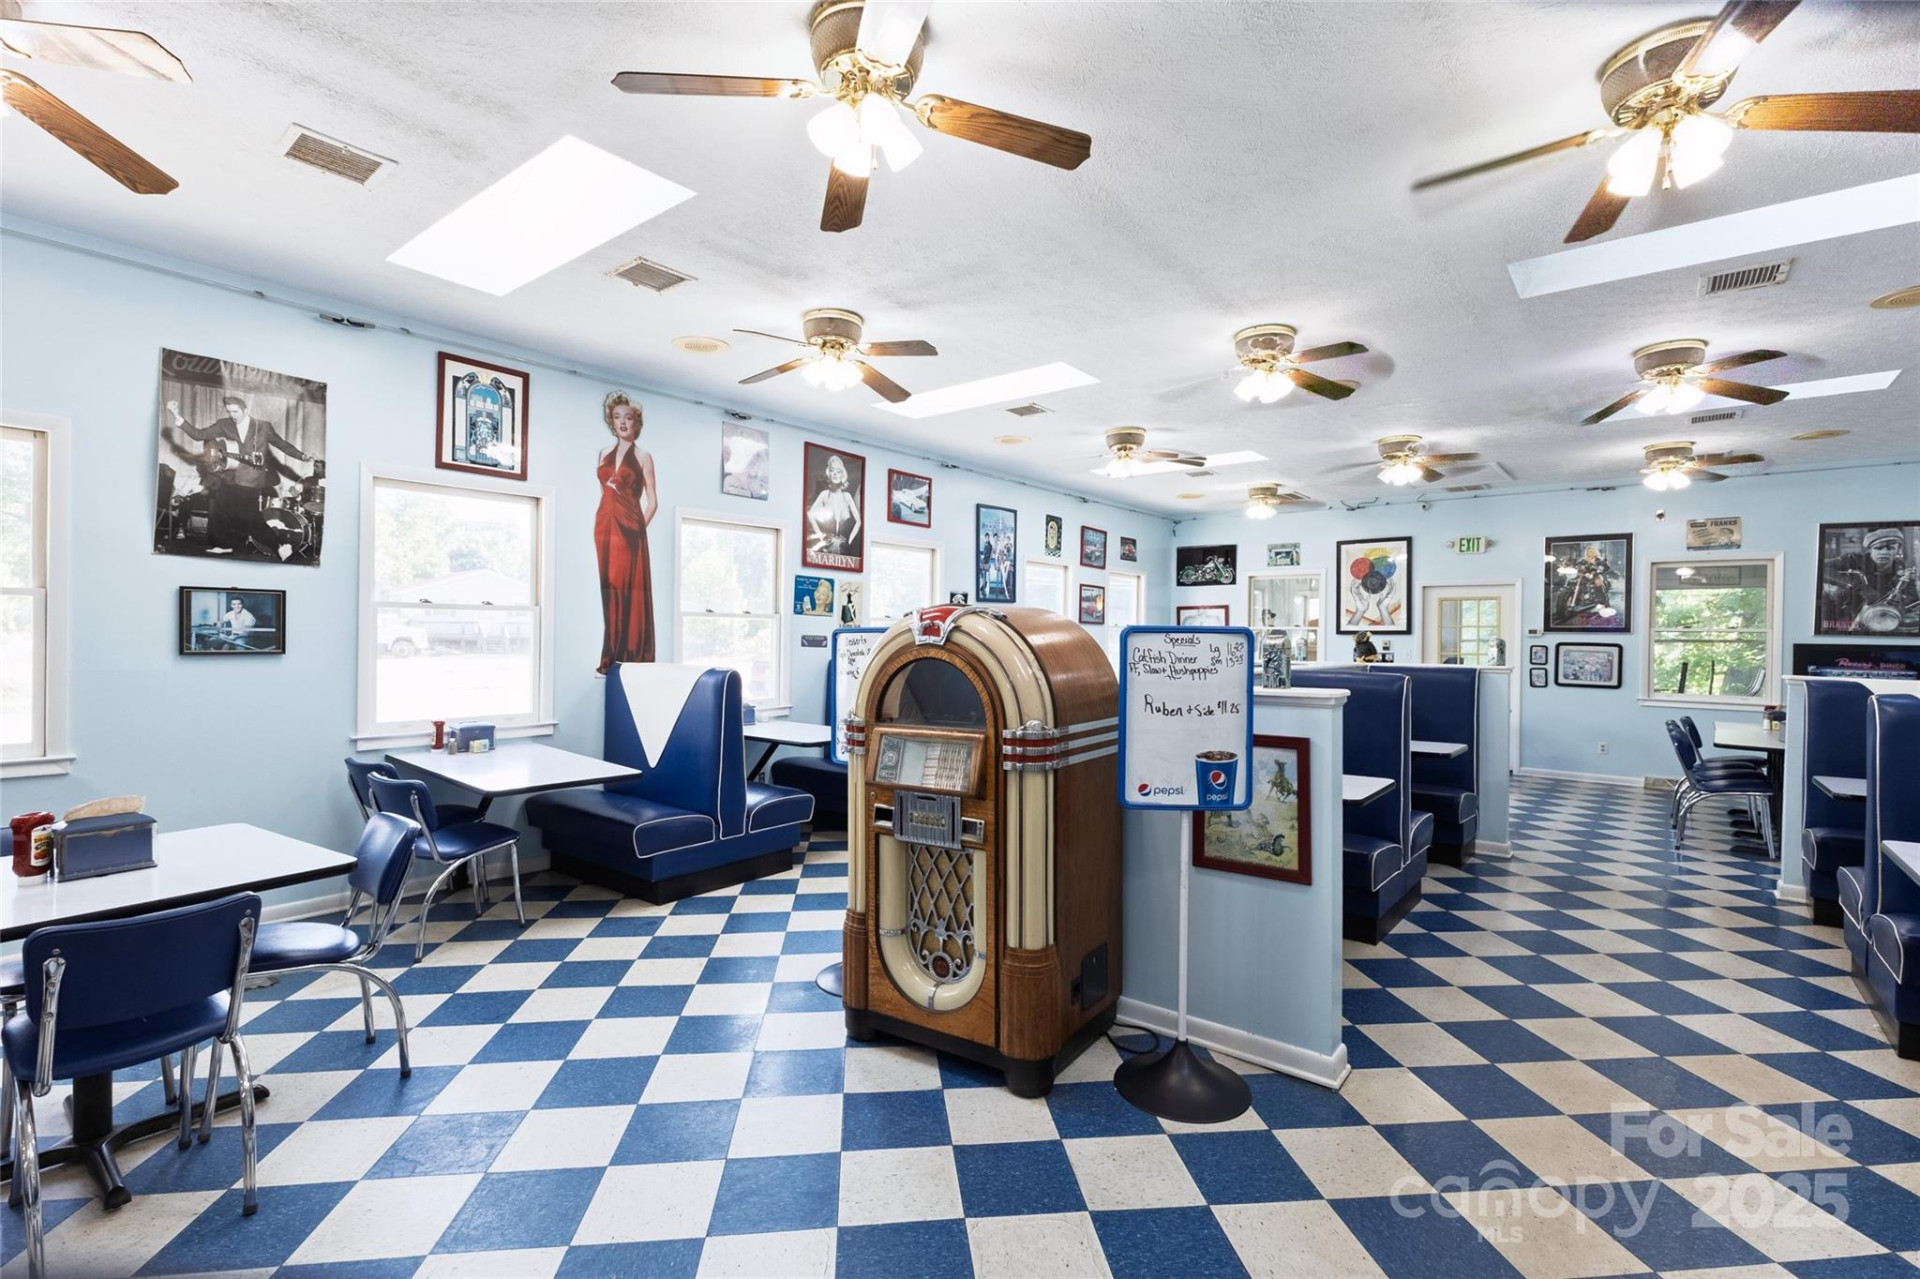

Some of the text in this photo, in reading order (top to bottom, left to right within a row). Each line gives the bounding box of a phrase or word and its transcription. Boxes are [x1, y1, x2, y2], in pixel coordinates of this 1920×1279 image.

[1459, 537, 1482, 553] EXIT
[812, 552, 856, 568] MARILYN
[1164, 632, 1201, 649] Specials
[1132, 647, 1167, 664] Catfish
[1165, 650, 1199, 665] Dinner
[1144, 693, 1184, 717] Ruben
[1193, 703, 1215, 718] Side
[1153, 785, 1184, 797] pepsi
[1206, 792, 1229, 802] pepsi
